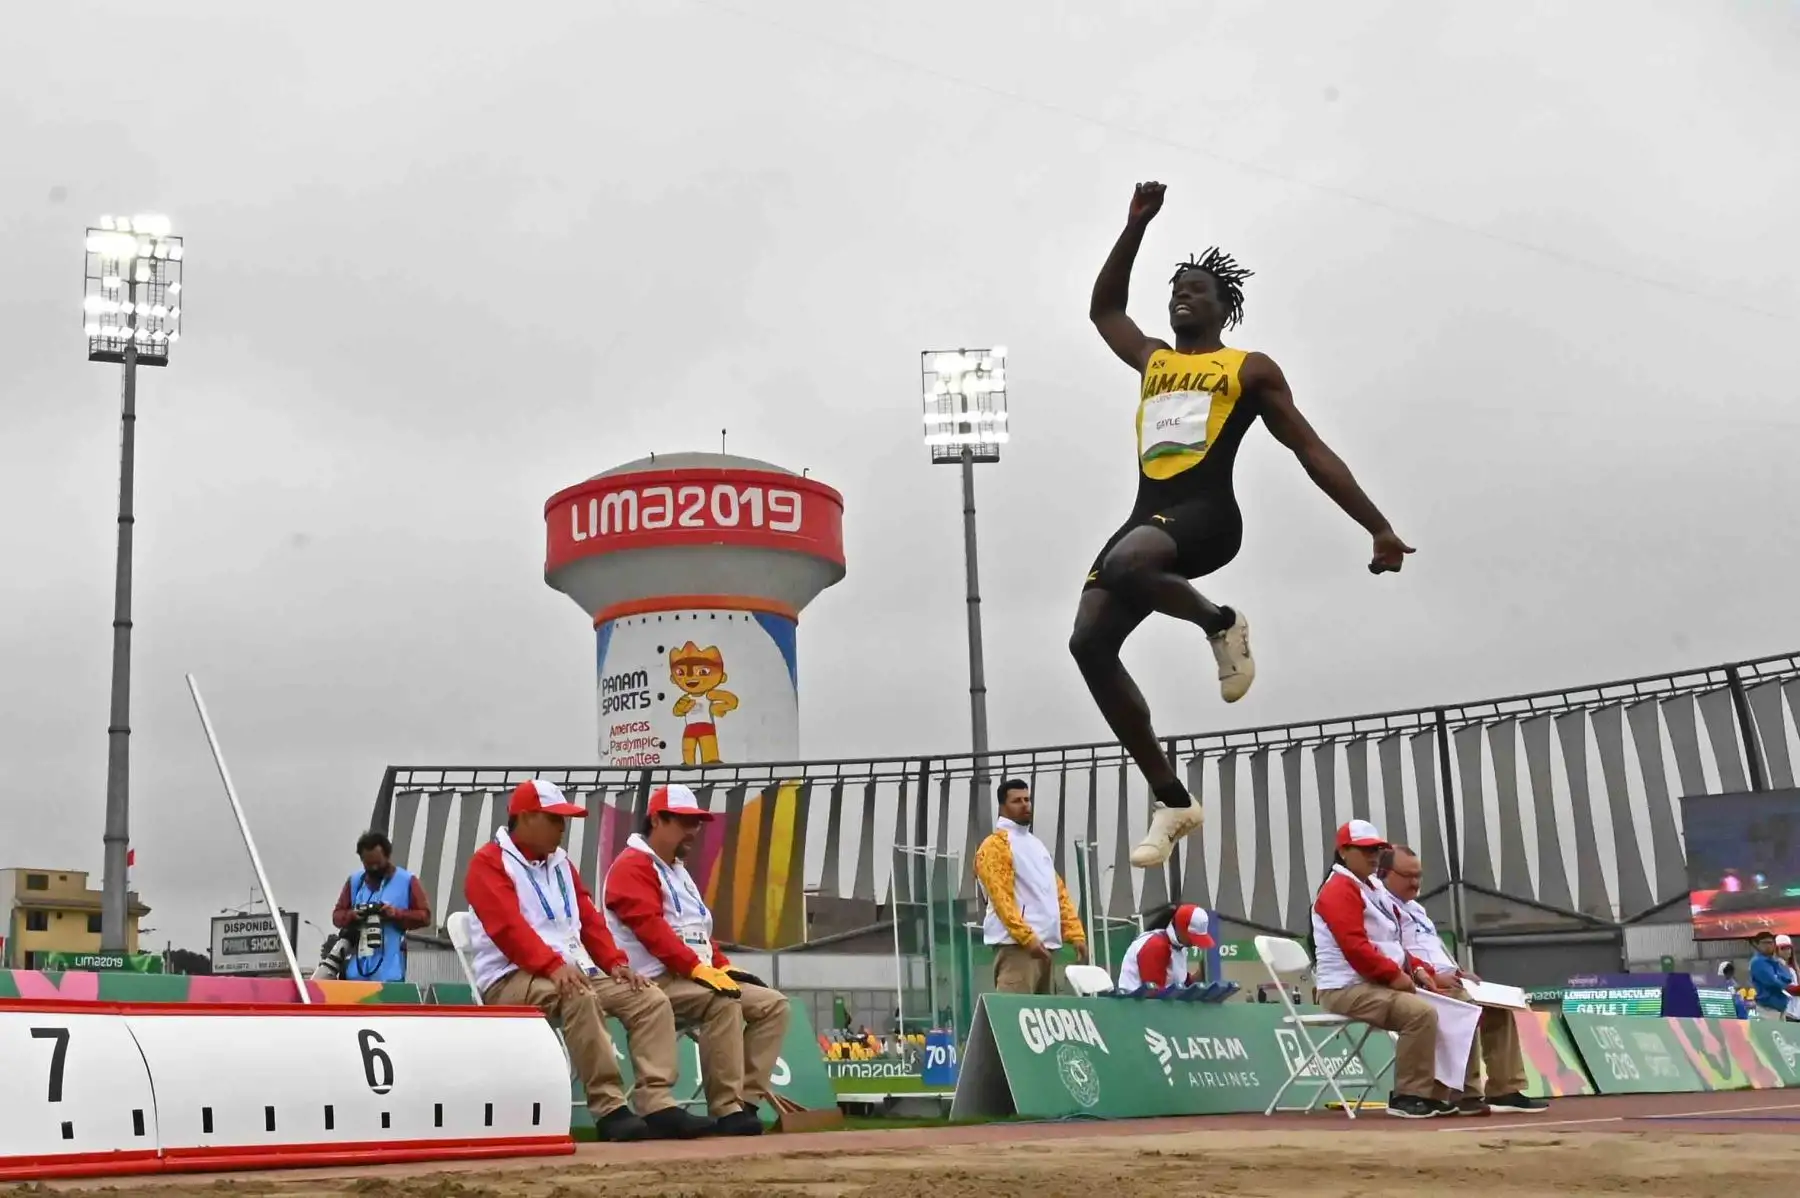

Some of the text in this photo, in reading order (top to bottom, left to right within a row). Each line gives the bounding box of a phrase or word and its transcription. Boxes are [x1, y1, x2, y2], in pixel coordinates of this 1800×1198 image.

[1143, 372, 1229, 398] JAMAICA
[1156, 417, 1181, 431] GAYLE
[602, 670, 648, 697] PANAM
[602, 690, 651, 716] SPORTS
[609, 720, 650, 738] Americas
[609, 736, 660, 755] Paralympic
[224, 920, 278, 934] DISPONIBL
[251, 936, 280, 951] SHOCK
[1576, 1003, 1617, 1015] GAYLE
[1018, 1007, 1109, 1054] GLORIA
[926, 1044, 947, 1069] 70
[1171, 1036, 1249, 1061] LATAM
[30, 1027, 70, 1102] 7
[357, 1028, 394, 1095] 6
[1188, 1071, 1261, 1088] AIRLINES
